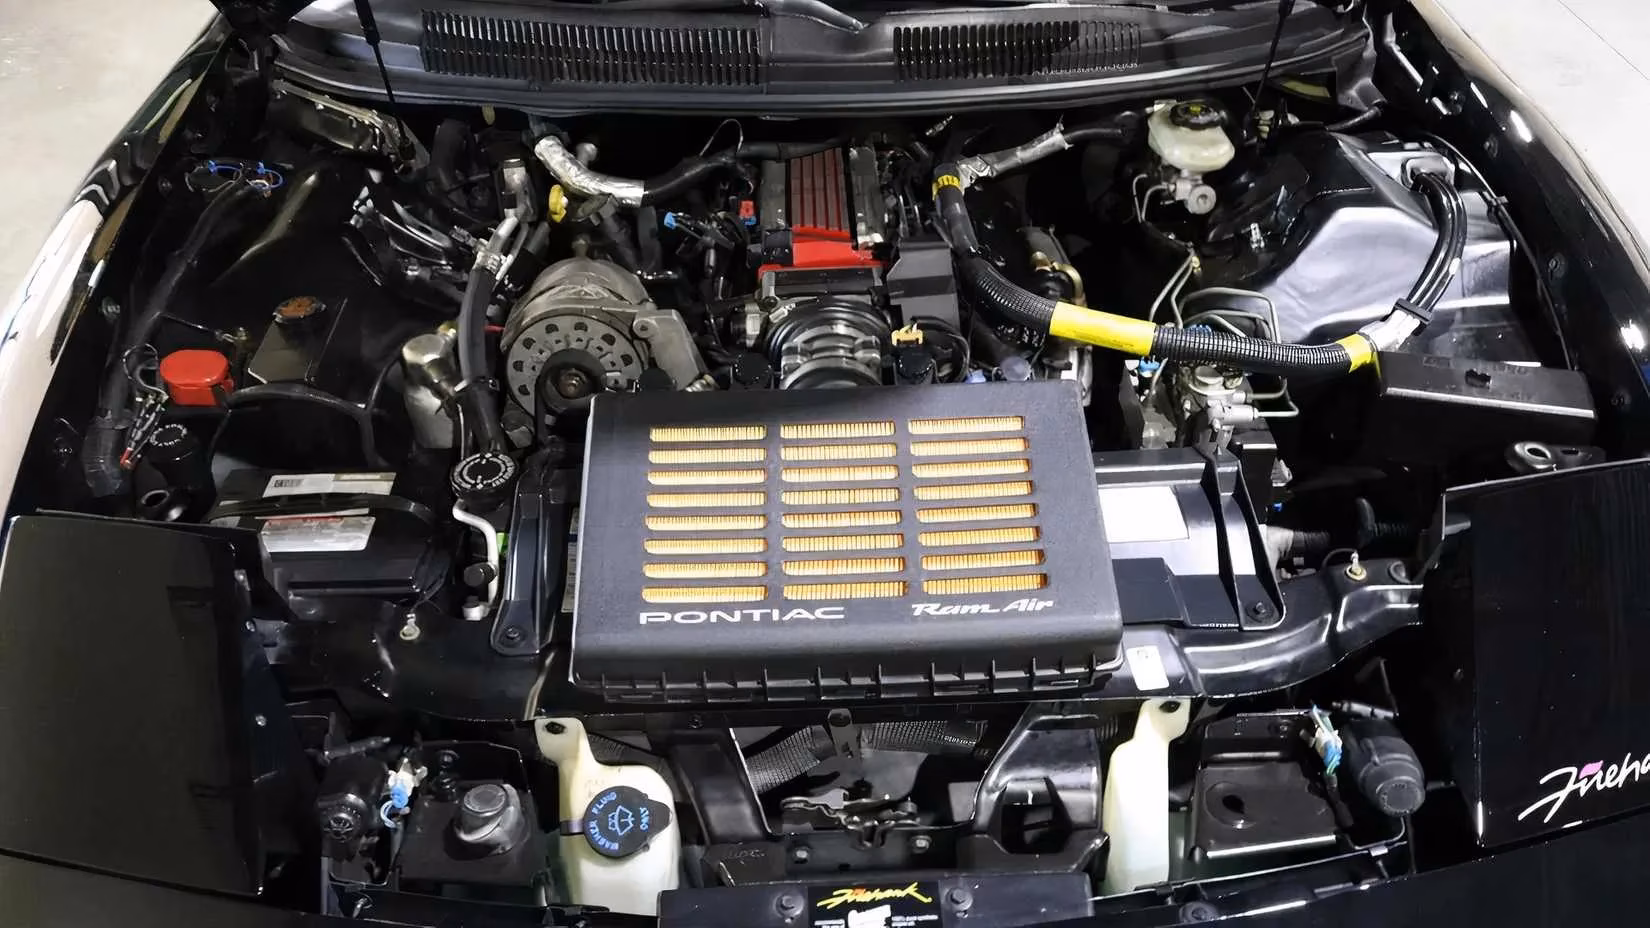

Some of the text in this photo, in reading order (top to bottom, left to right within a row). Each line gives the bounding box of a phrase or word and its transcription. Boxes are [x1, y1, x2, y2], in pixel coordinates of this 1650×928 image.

[639, 606, 846, 625] PONTIAC
[911, 598, 1054, 616] Ram Air
[591, 791, 617, 815] FLUID
